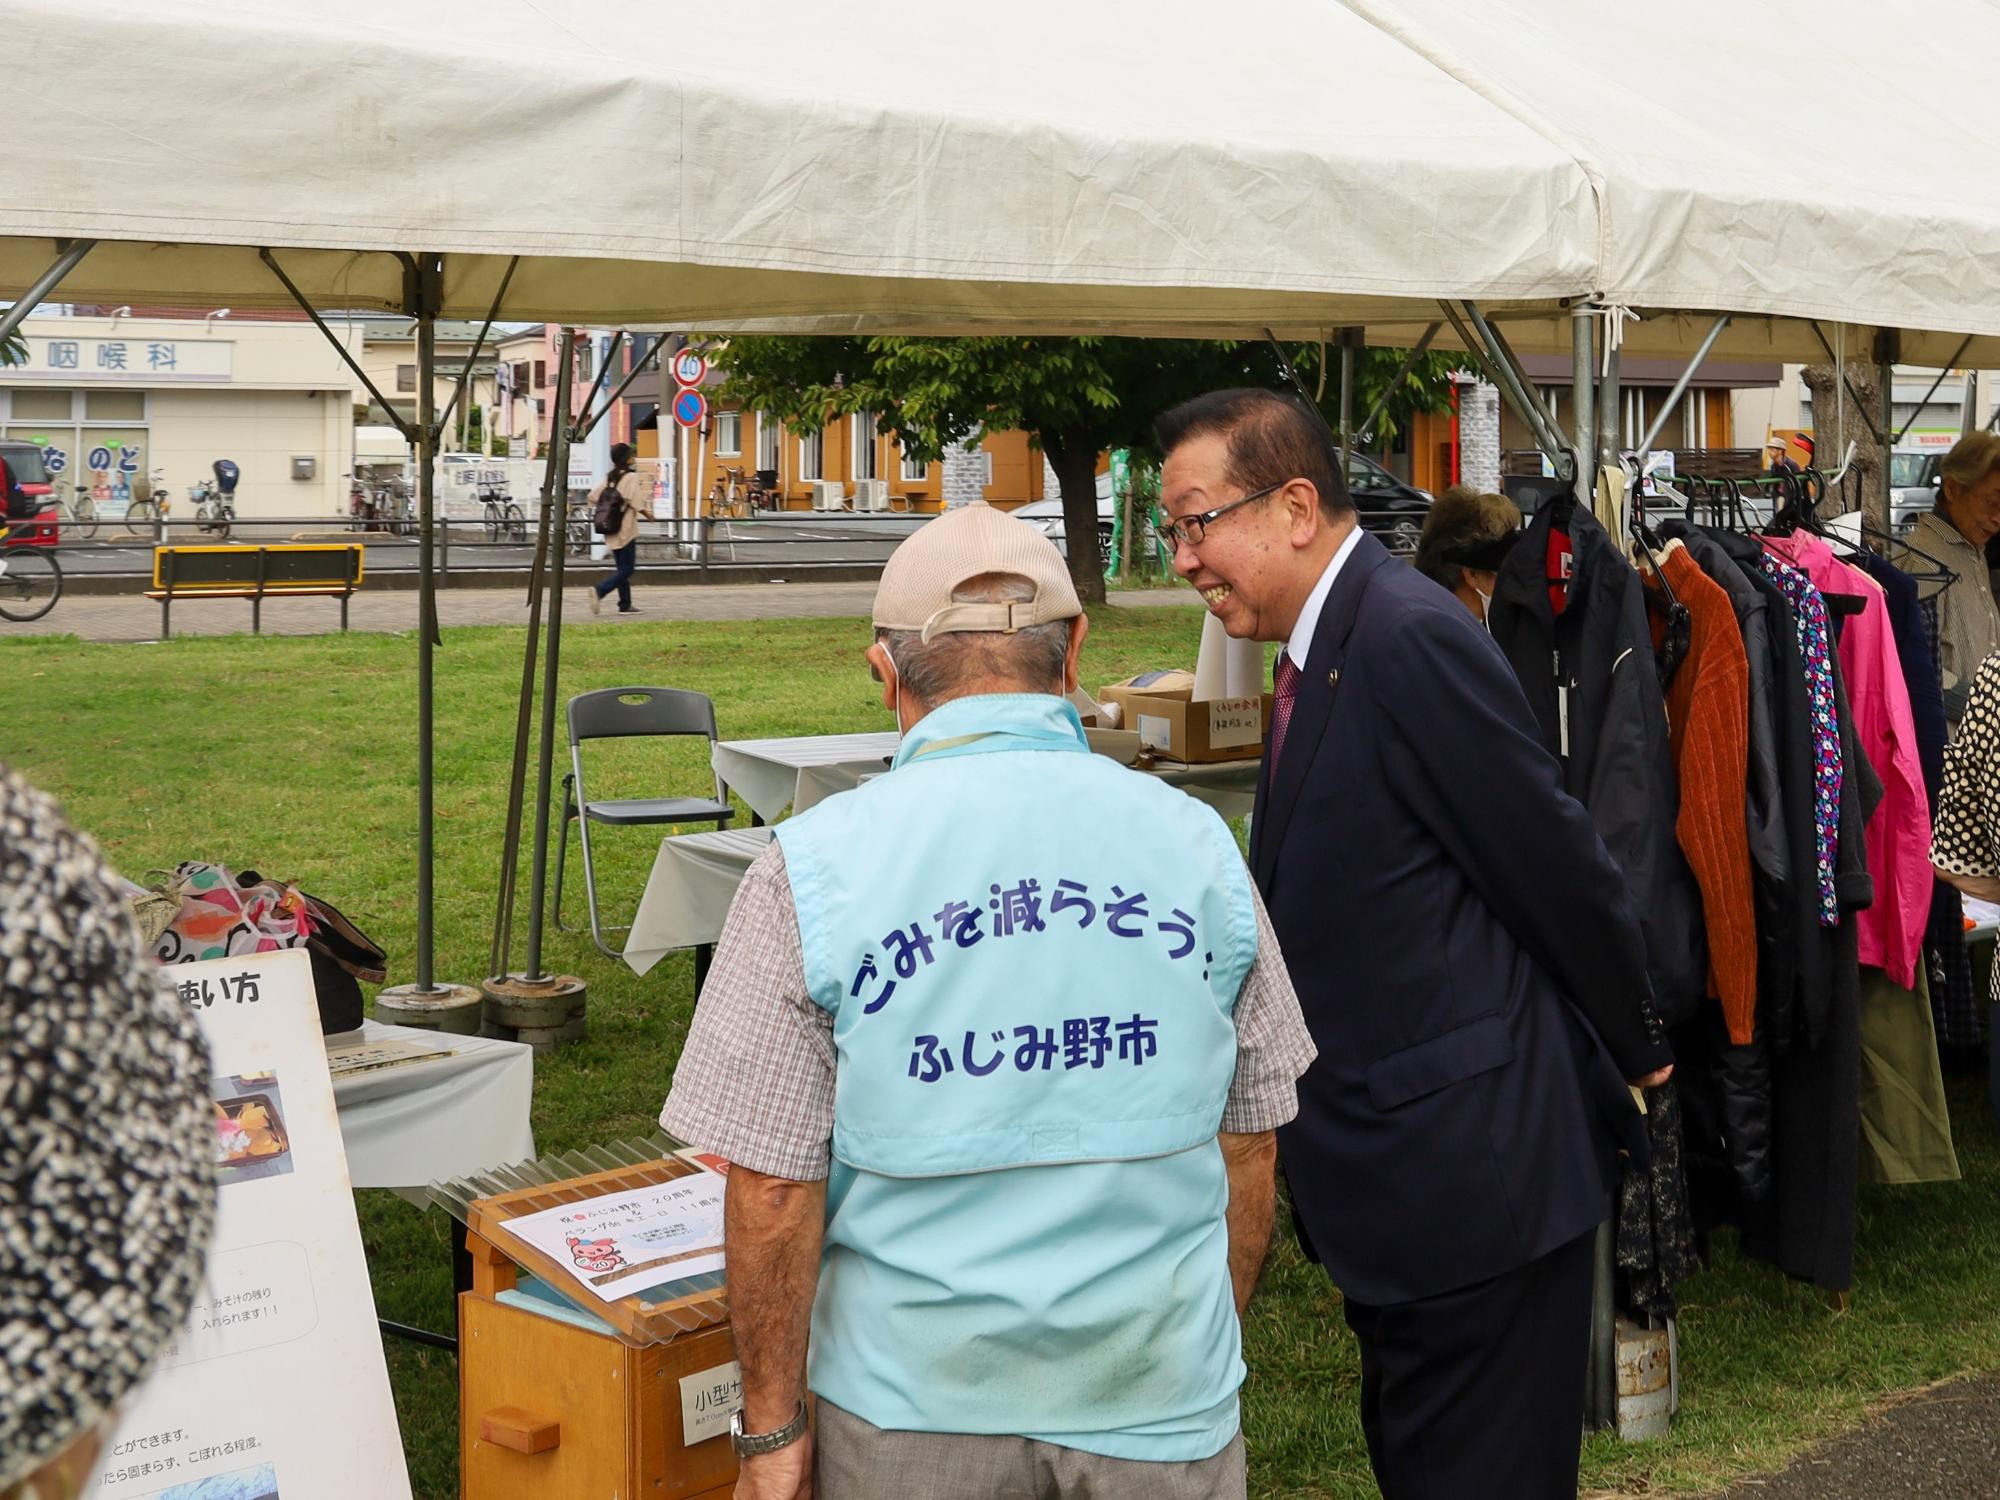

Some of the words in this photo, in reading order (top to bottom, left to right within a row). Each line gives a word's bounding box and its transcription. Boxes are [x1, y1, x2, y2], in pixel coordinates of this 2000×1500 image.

[680, 357, 698, 375] 40
[88, 446, 141, 472] のど
[850, 878, 1213, 1014] ごみを減らそう!
[907, 1012, 1159, 1083] ふじみ野市
[592, 1261, 609, 1270] 20
[105, 1428, 189, 1458] とができます。
